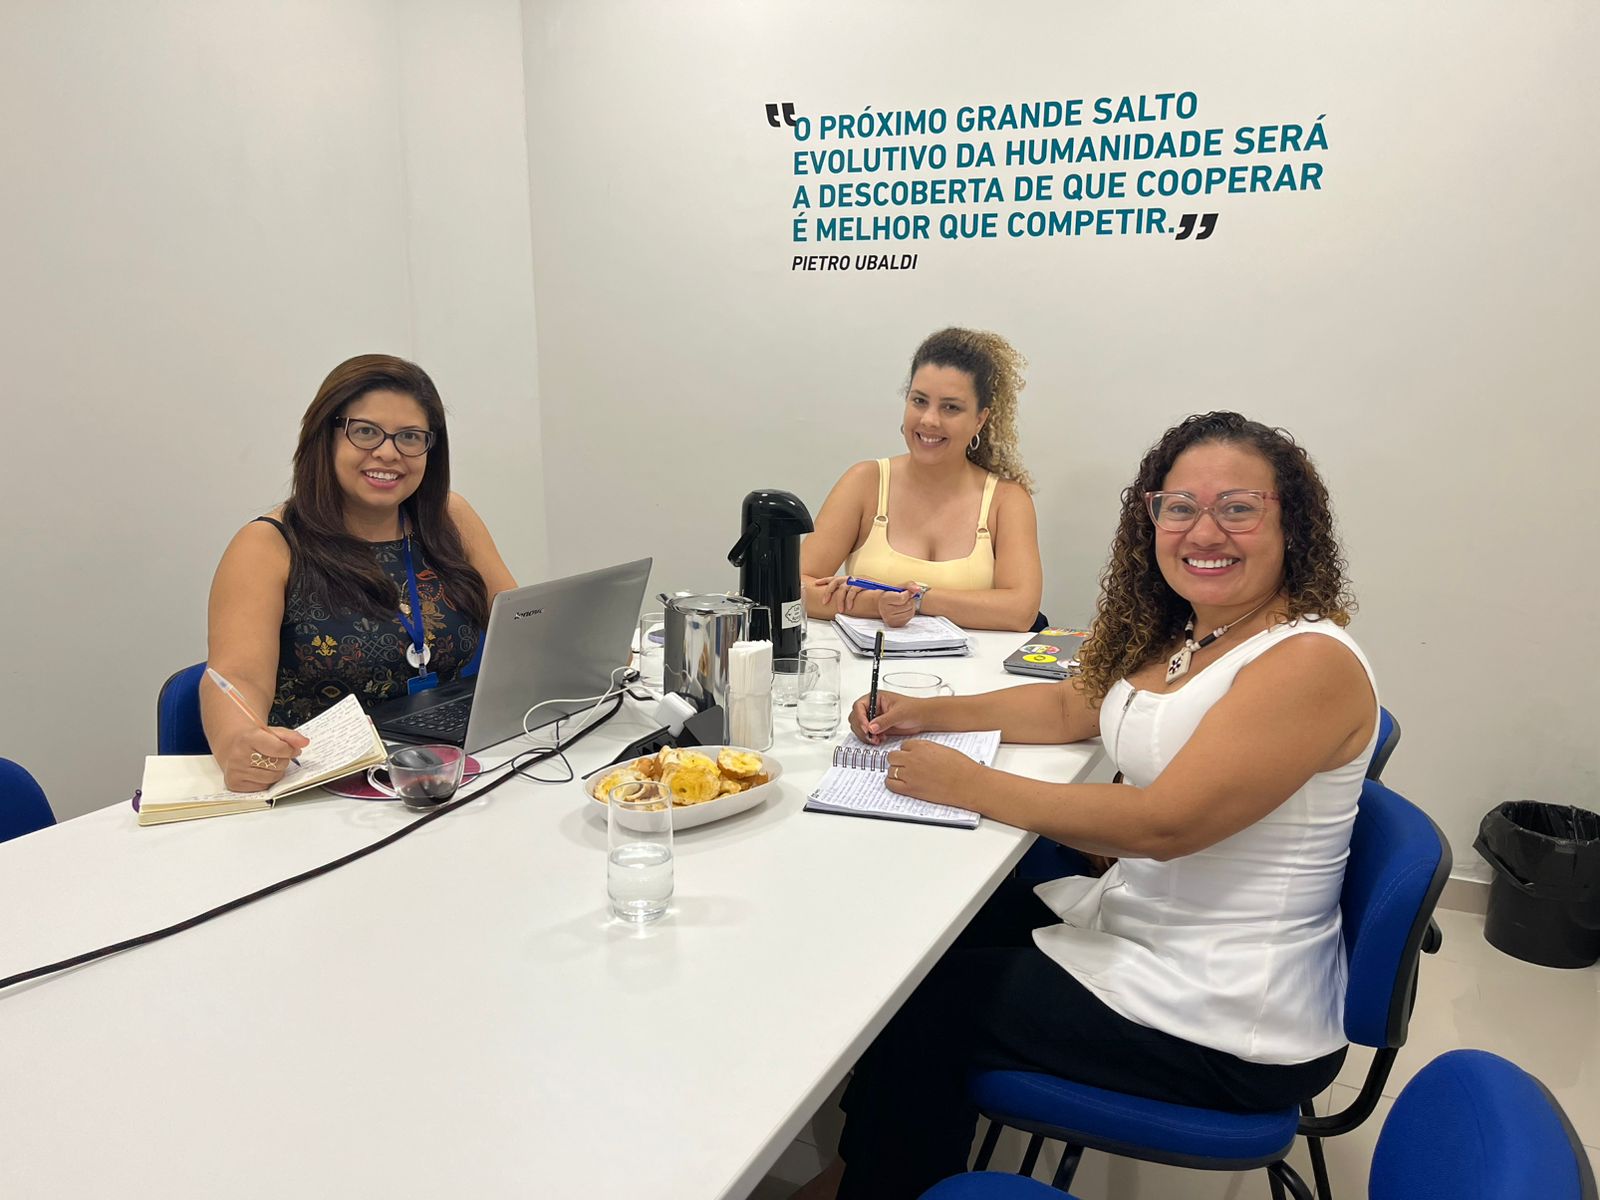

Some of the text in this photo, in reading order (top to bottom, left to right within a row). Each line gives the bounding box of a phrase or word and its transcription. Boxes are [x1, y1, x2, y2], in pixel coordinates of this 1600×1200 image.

[820, 105, 947, 140] PRÓXIMO
[956, 99, 1084, 133] GRANDE
[1092, 91, 1198, 125] SALTO
[793, 113, 1329, 176] EVOLUTIVO DA HUMANIDADE SERÁ
[792, 162, 1324, 210] A DESCOBERTA DE QUE COOPERAR
[792, 211, 808, 242] É
[816, 214, 931, 243] MELHOR
[939, 212, 999, 241] QUE
[791, 253, 918, 271] PIETRO UBALDI
